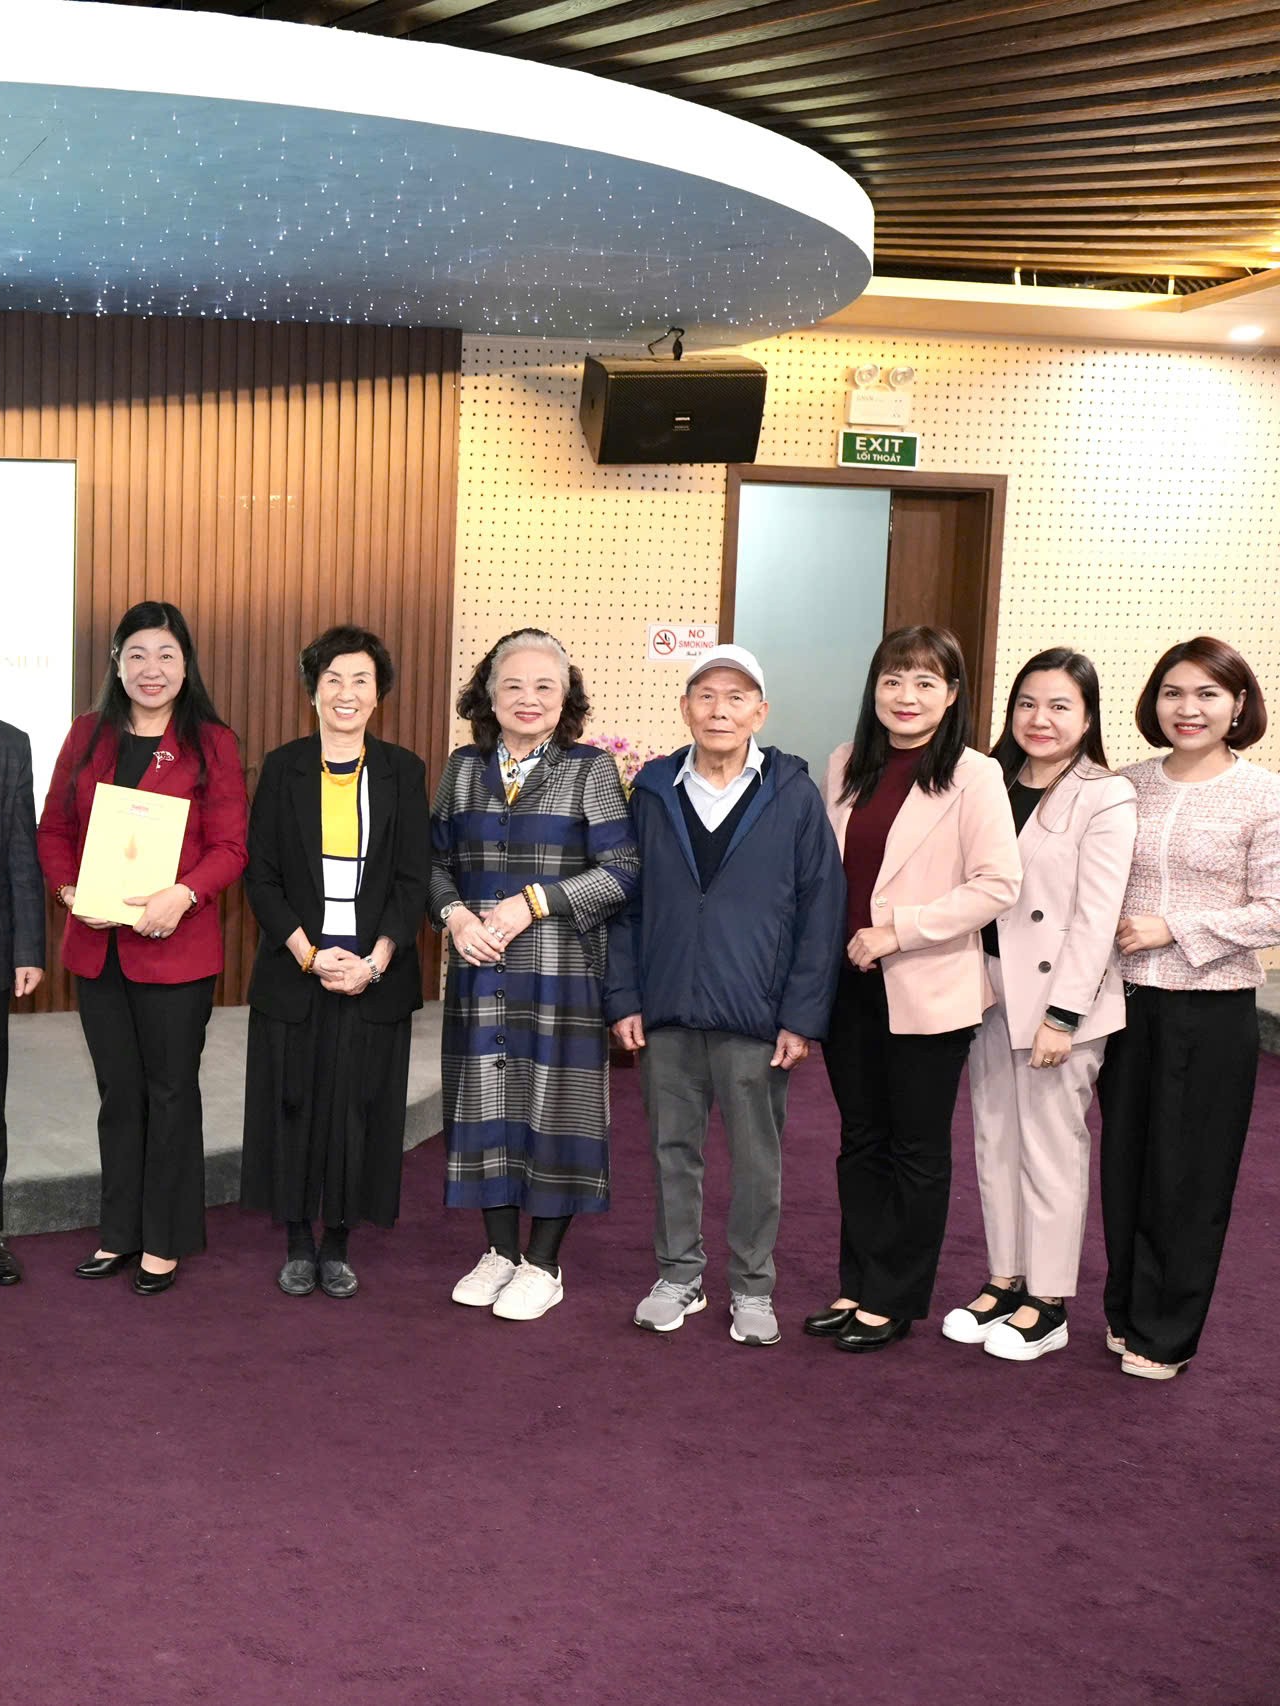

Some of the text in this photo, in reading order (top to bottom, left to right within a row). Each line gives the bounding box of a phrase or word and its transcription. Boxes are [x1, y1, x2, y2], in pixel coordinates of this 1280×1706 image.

[855, 436, 904, 453] EXIT
[873, 452, 902, 463] THOÁT
[688, 629, 705, 639] NO
[678, 640, 714, 649] SMOKING
